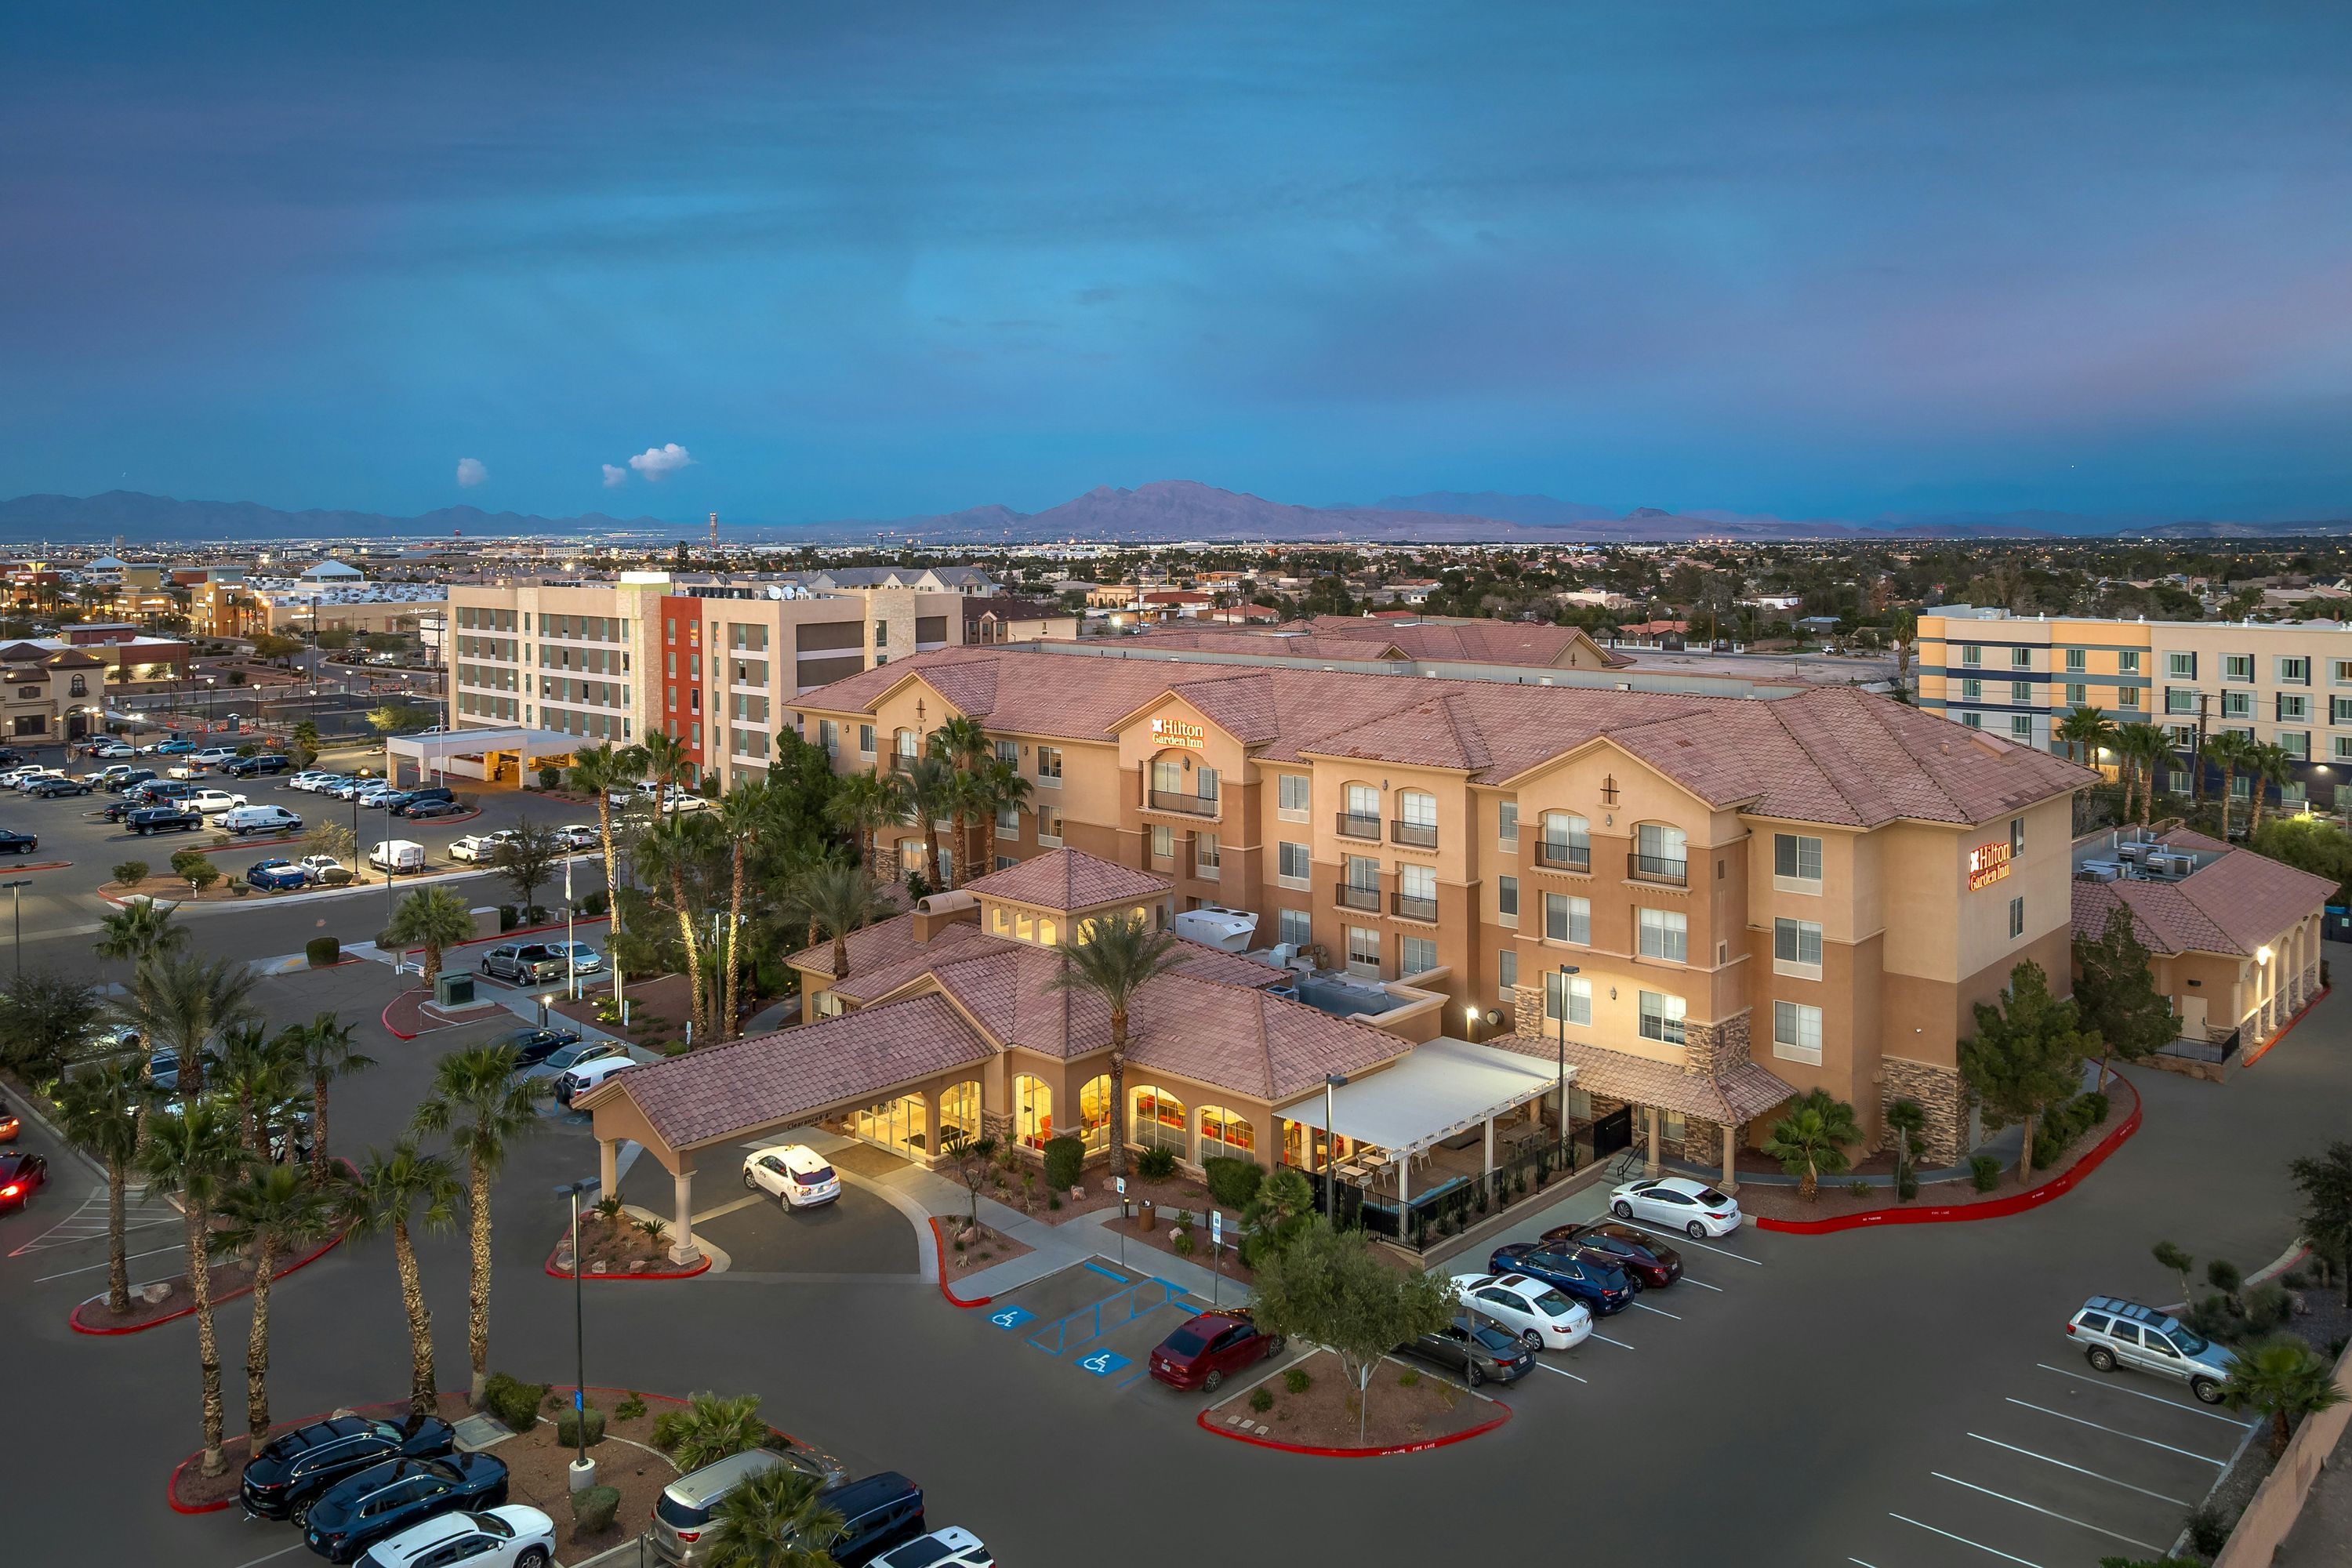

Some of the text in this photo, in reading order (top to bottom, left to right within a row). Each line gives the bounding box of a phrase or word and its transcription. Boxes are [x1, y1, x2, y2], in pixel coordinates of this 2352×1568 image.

[1163, 719, 1203, 737] Hilton
[1152, 733, 1203, 748] Garden Inn
[1980, 843, 2009, 870] Hilton
[1970, 864, 2009, 891] Garden Inn
[787, 1117, 818, 1129] Clearance
